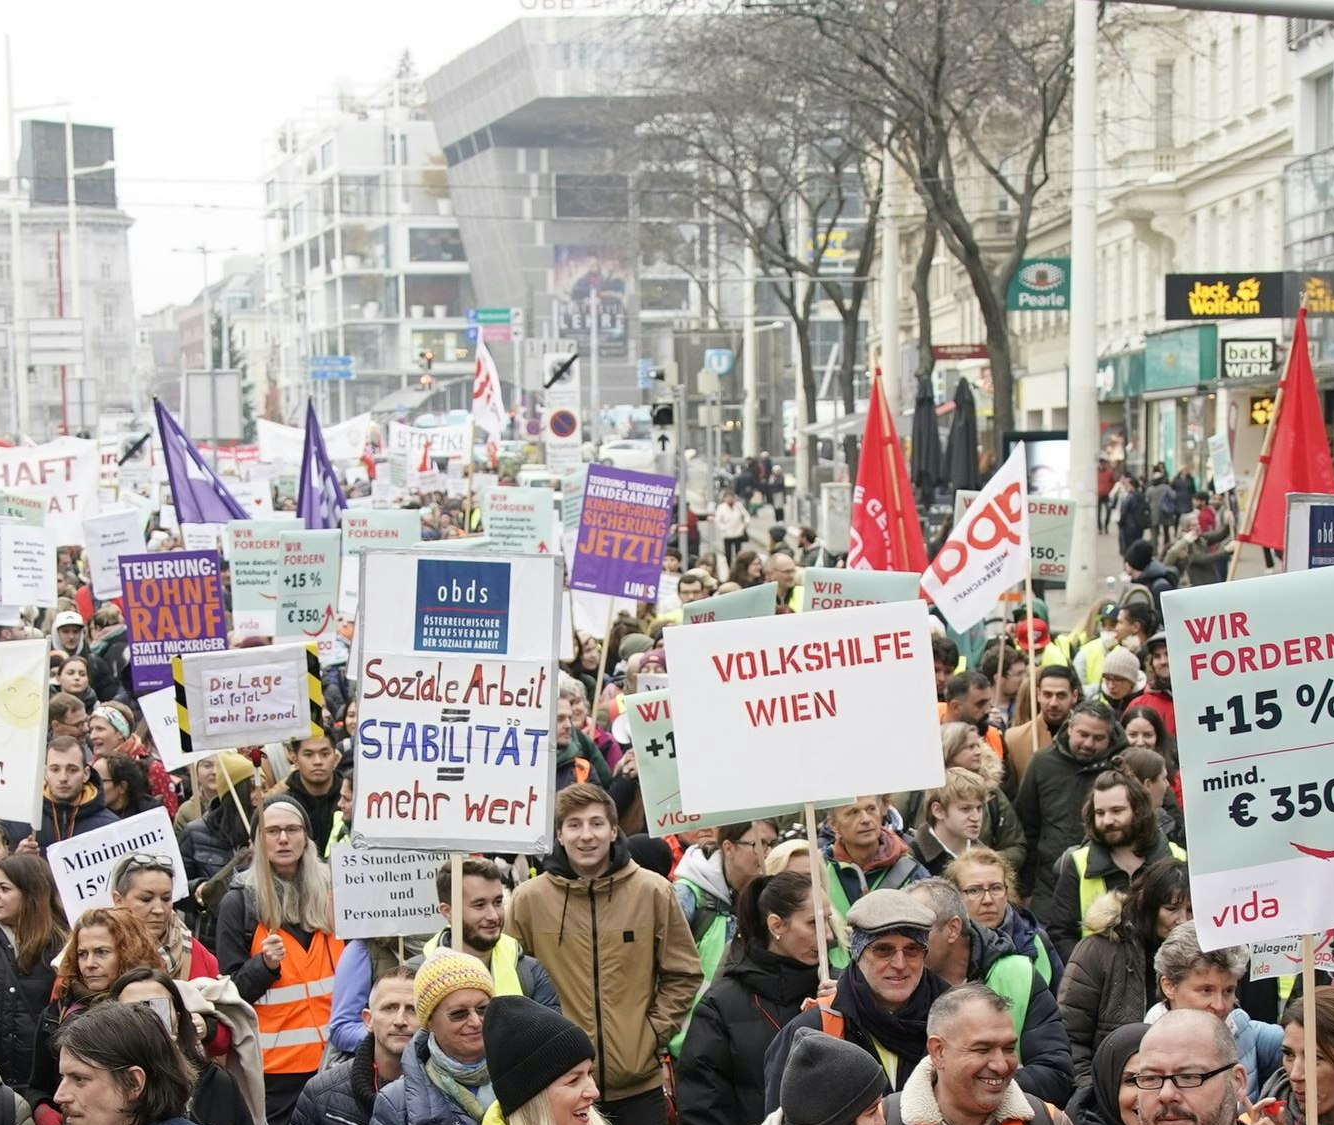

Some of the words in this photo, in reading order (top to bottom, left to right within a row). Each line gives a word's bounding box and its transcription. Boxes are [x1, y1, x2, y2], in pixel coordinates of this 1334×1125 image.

[1017, 290, 1065, 308] Pearle
[1189, 280, 1229, 300] Jack
[1189, 294, 1260, 316] Wolfskin
[1229, 342, 1269, 360] back
[589, 476, 627, 489] TEUERUNG
[628, 481, 673, 497] VERSCHÄRFT
[490, 494, 508, 502] WIR
[587, 485, 671, 509] KINDERARMUT.
[490, 504, 535, 512] FORDERN
[348, 519, 368, 527] WIR
[582, 511, 666, 535] SICHERUNG
[234, 529, 253, 538] WIR
[348, 530, 399, 538] FORDERN
[285, 542, 302, 551] WIR
[579, 527, 663, 565] JETZT!
[121, 557, 217, 580] TEUERUNG:
[284, 555, 325, 565] FORDERN
[1039, 563, 1065, 575] gpa
[284, 573, 306, 587] +15
[310, 571, 322, 587] %
[813, 581, 843, 595] WIR
[125, 577, 220, 608] LÖHNE
[437, 578, 488, 603] obds
[128, 604, 222, 642] RAUF
[288, 610, 294, 623] €
[298, 609, 324, 623] 350,-
[424, 614, 500, 628] ÖSTERREICHISCHER
[423, 626, 499, 639] BERUFSVERBAND
[1184, 612, 1250, 644] WIR
[132, 641, 162, 655] STATT
[163, 638, 225, 653] MICKRIGER
[422, 638, 437, 647] DER
[438, 638, 472, 648] SOZIALEN
[474, 640, 499, 650] ARBEIT
[711, 630, 914, 683] VOLKSHILFE
[210, 677, 233, 691] Die
[237, 673, 283, 695] Lage
[363, 659, 459, 703] Soziale
[463, 663, 546, 709] Arbeit
[210, 694, 228, 705] ist
[230, 692, 261, 707] fatal
[745, 689, 838, 727] WIEN
[209, 711, 240, 724] mehr
[244, 706, 298, 723] Personal
[1197, 689, 1283, 735] +15
[359, 718, 548, 766] STABILITÄT
[1202, 765, 1265, 792] mind.
[367, 780, 450, 821] mehr
[465, 786, 538, 826] wert
[1228, 793, 1258, 827] €
[62, 827, 164, 874] Minimum:
[341, 855, 357, 867] 35
[345, 873, 364, 885] bei
[369, 871, 412, 884] vollem
[390, 887, 414, 900] und
[1212, 890, 1279, 927] vida
[1253, 943, 1298, 955] Zulagen!
